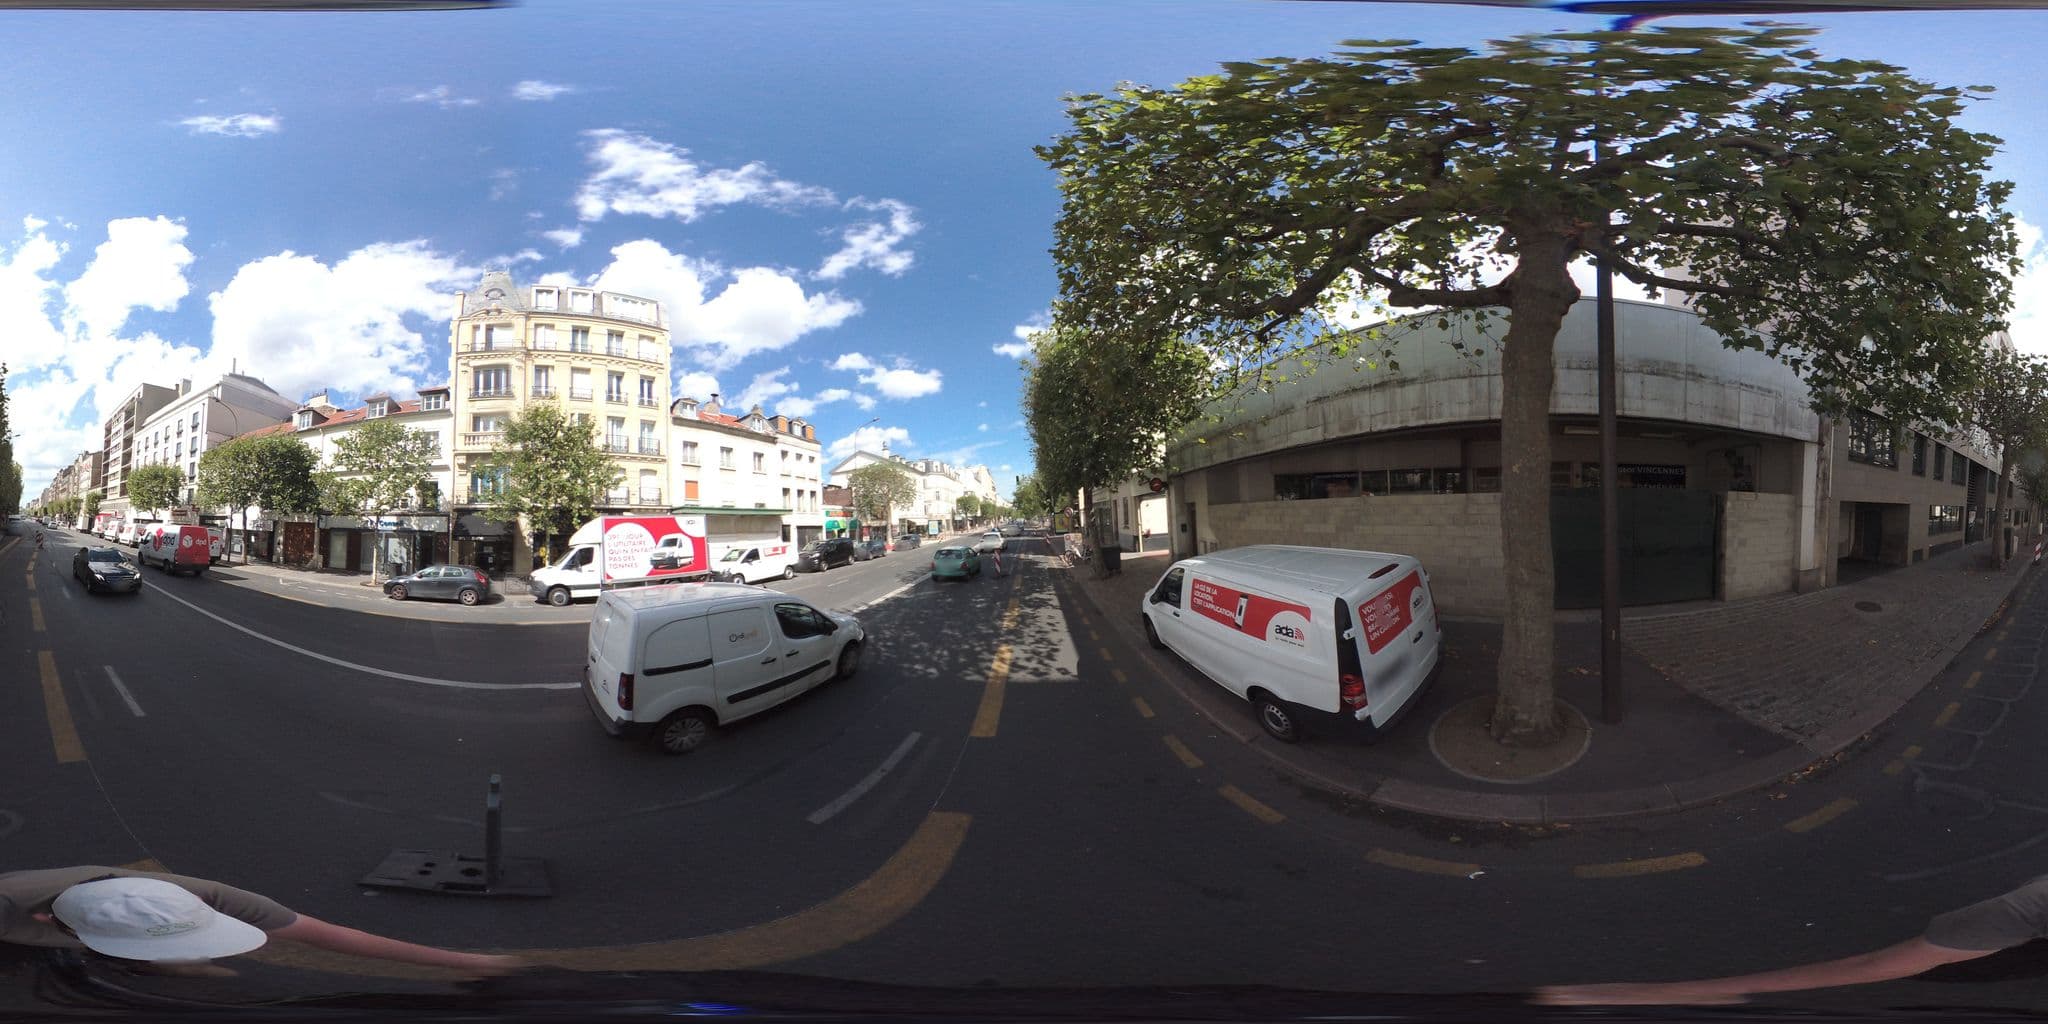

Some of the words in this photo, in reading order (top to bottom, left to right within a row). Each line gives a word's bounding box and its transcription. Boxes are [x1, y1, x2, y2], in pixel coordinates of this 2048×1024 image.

[1637, 465, 1685, 475] VINCENNES
[195, 536, 207, 546] dpd
[1274, 624, 1294, 638] ada
